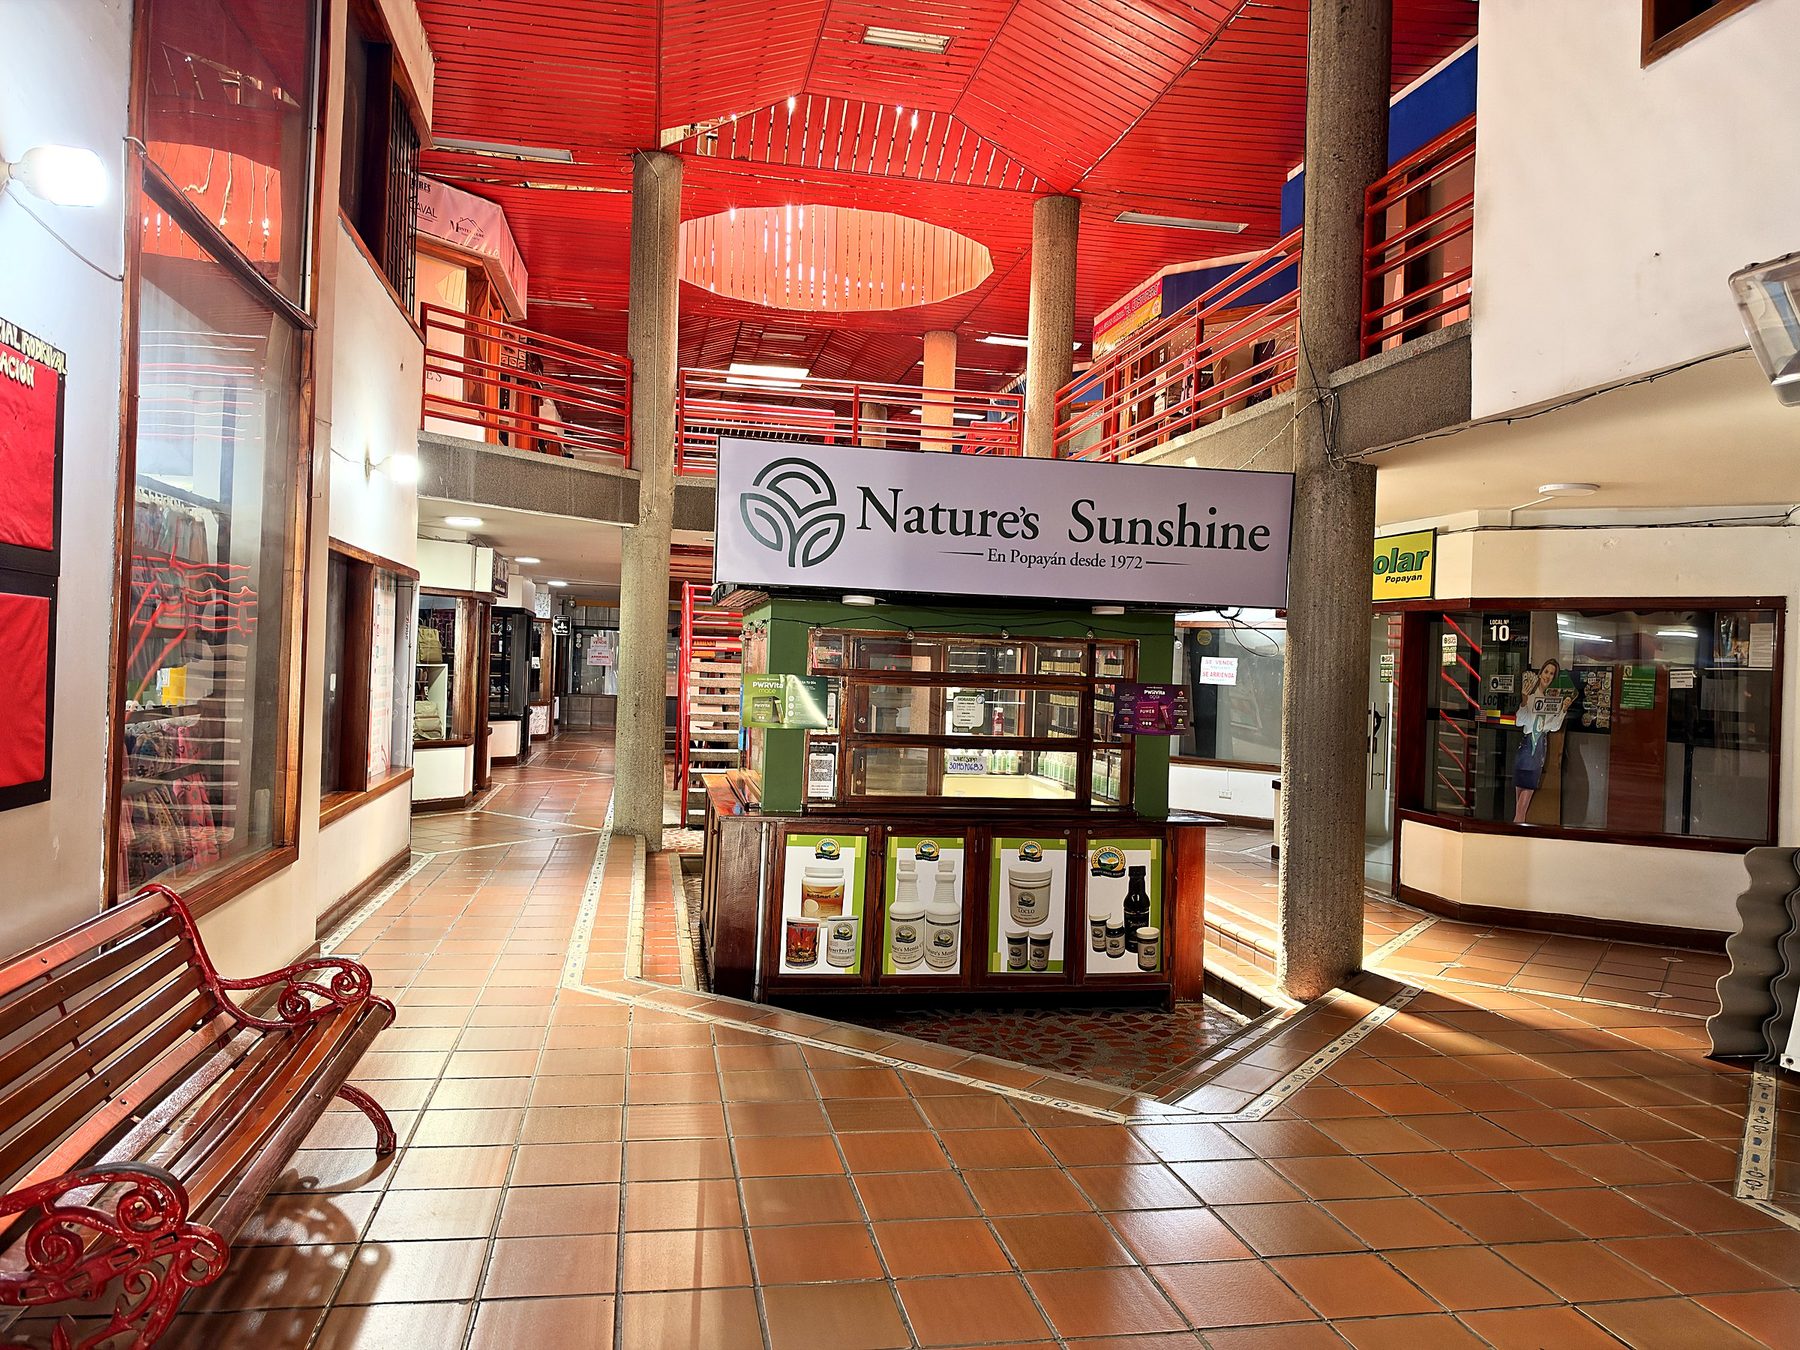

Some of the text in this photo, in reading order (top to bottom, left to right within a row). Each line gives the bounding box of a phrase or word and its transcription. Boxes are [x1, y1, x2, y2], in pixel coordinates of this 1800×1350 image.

[21, 331, 68, 374] RODRIVAL
[856, 486, 1271, 552] Nature's Sunshine
[986, 547, 1143, 570] En Popayán desde 1972
[1489, 625, 1510, 642] 10
